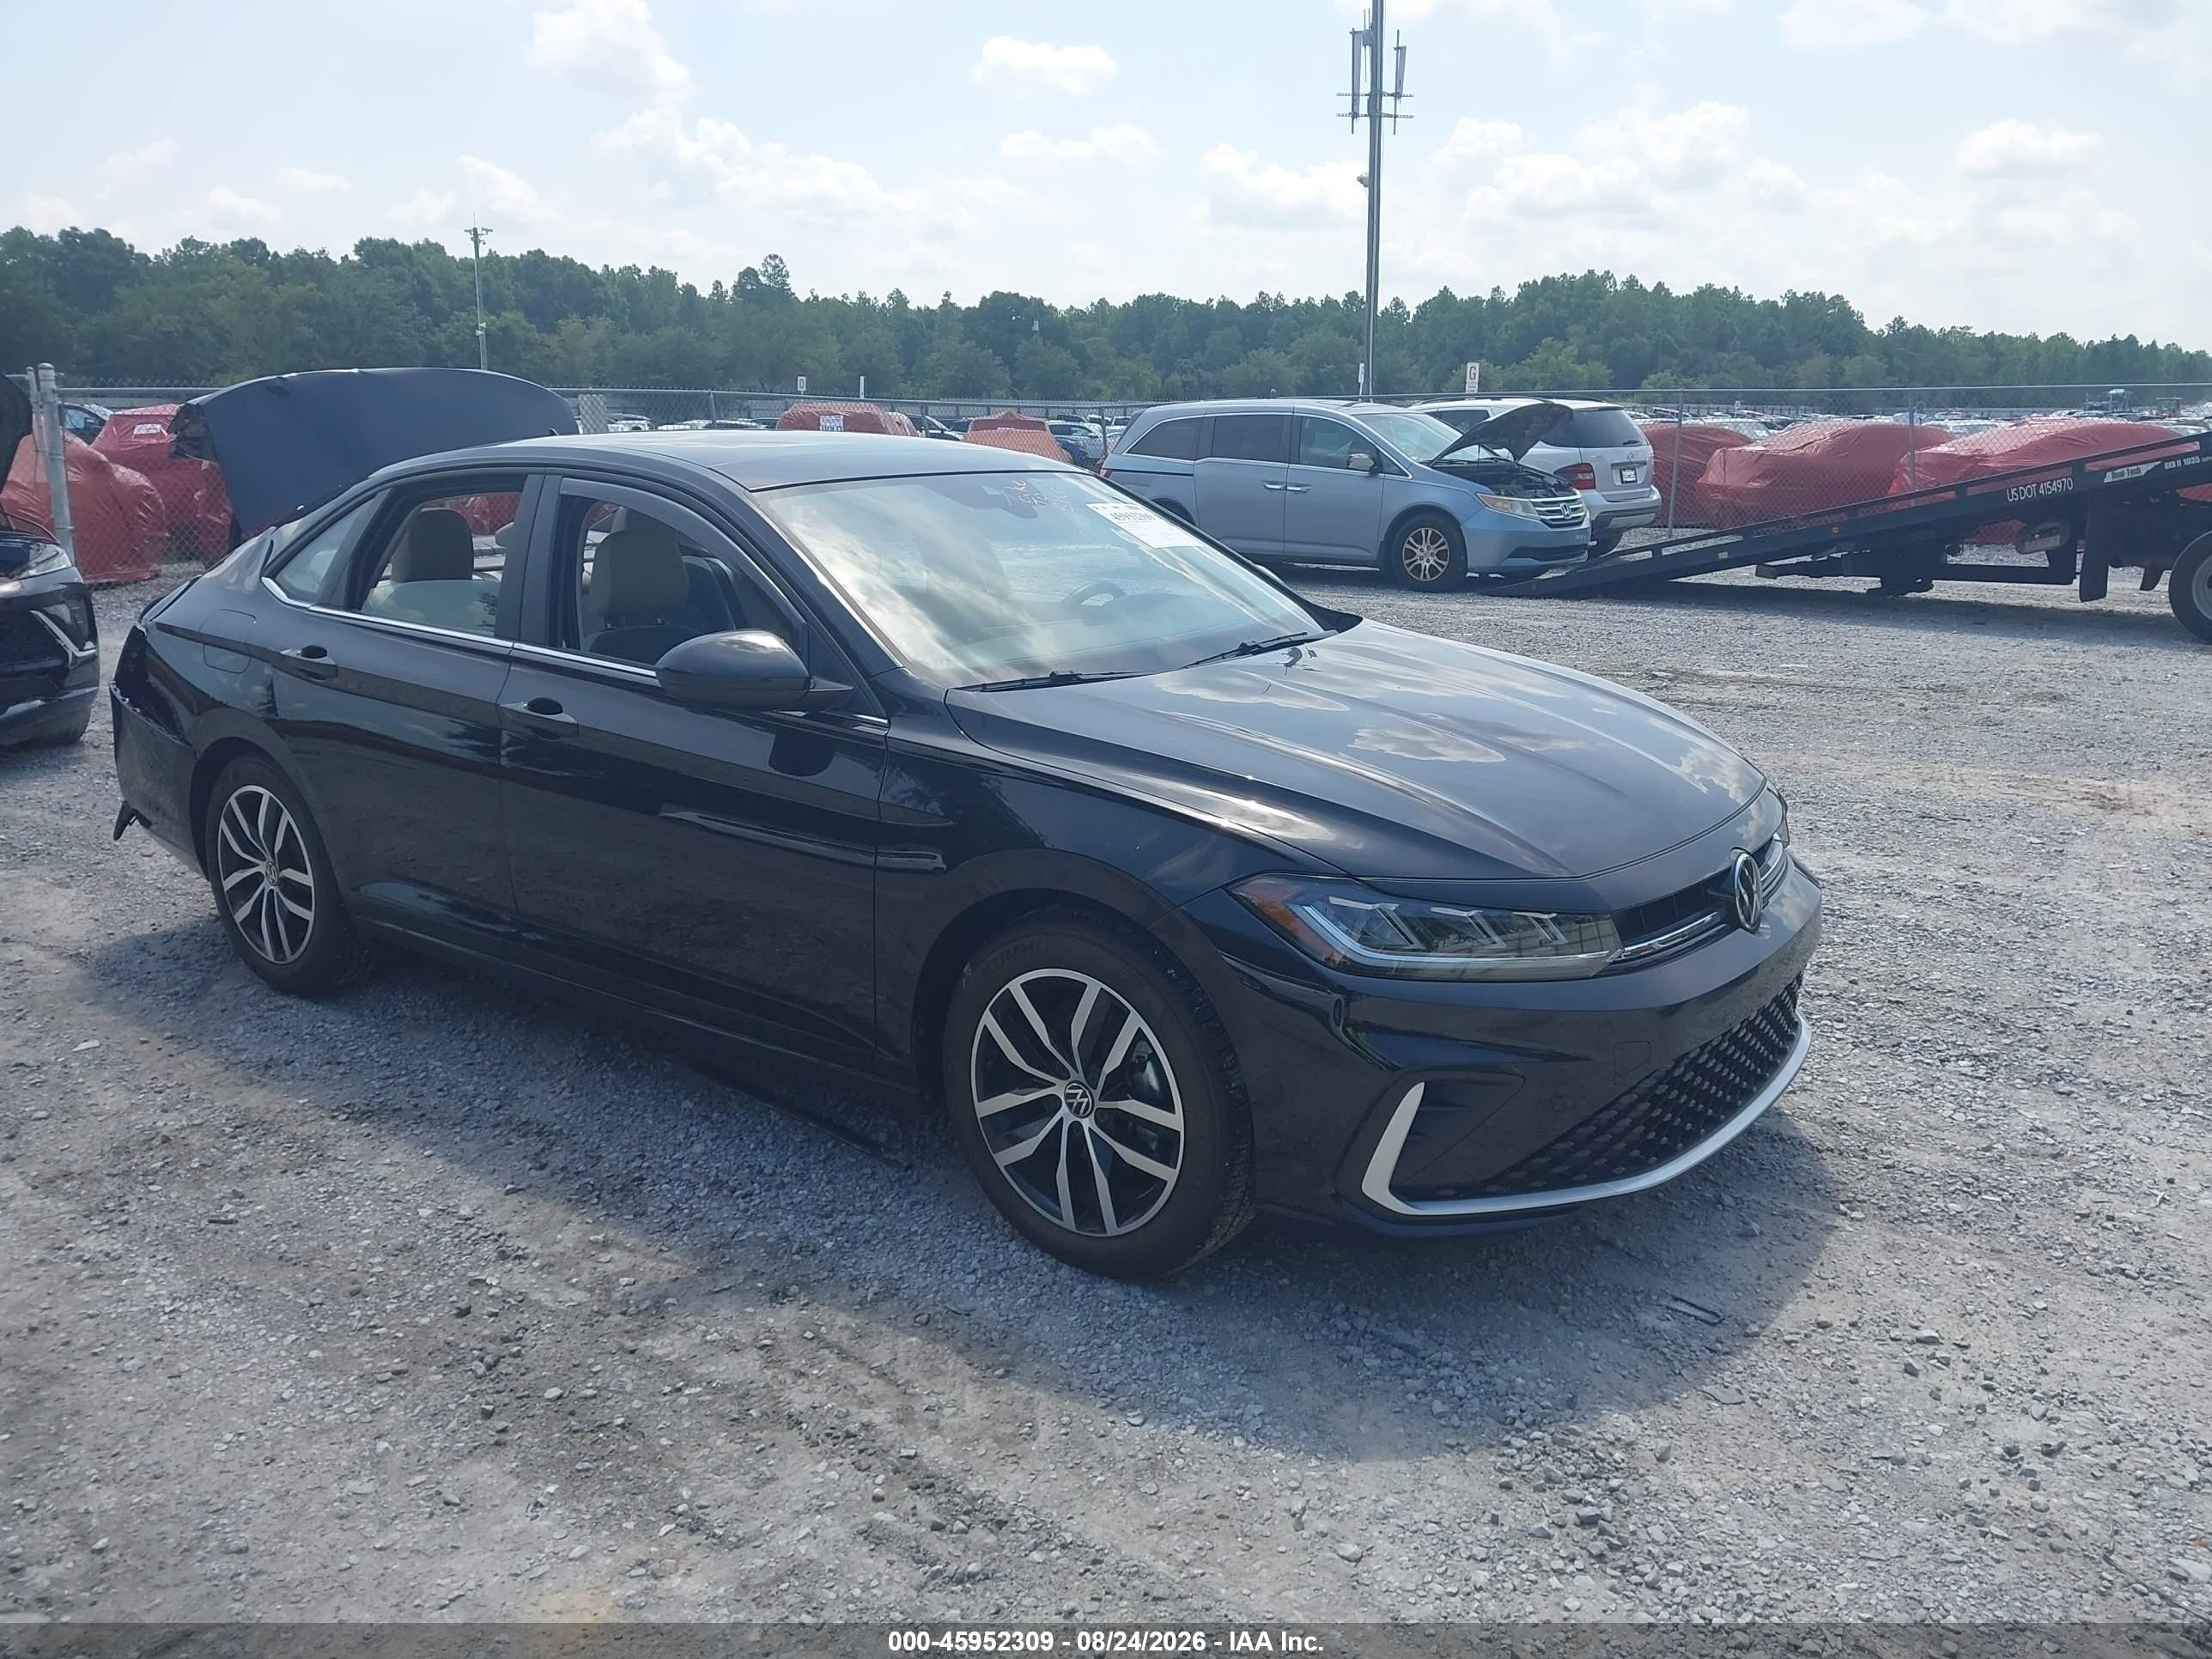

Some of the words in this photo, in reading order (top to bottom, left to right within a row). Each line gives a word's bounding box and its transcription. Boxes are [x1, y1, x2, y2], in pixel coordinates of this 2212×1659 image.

[1469, 366, 1477, 380] G
[2183, 455, 2201, 465] 1035
[2006, 488, 2019, 502] US
[2019, 483, 2037, 500] DOT
[2039, 477, 2074, 495] 4154970
